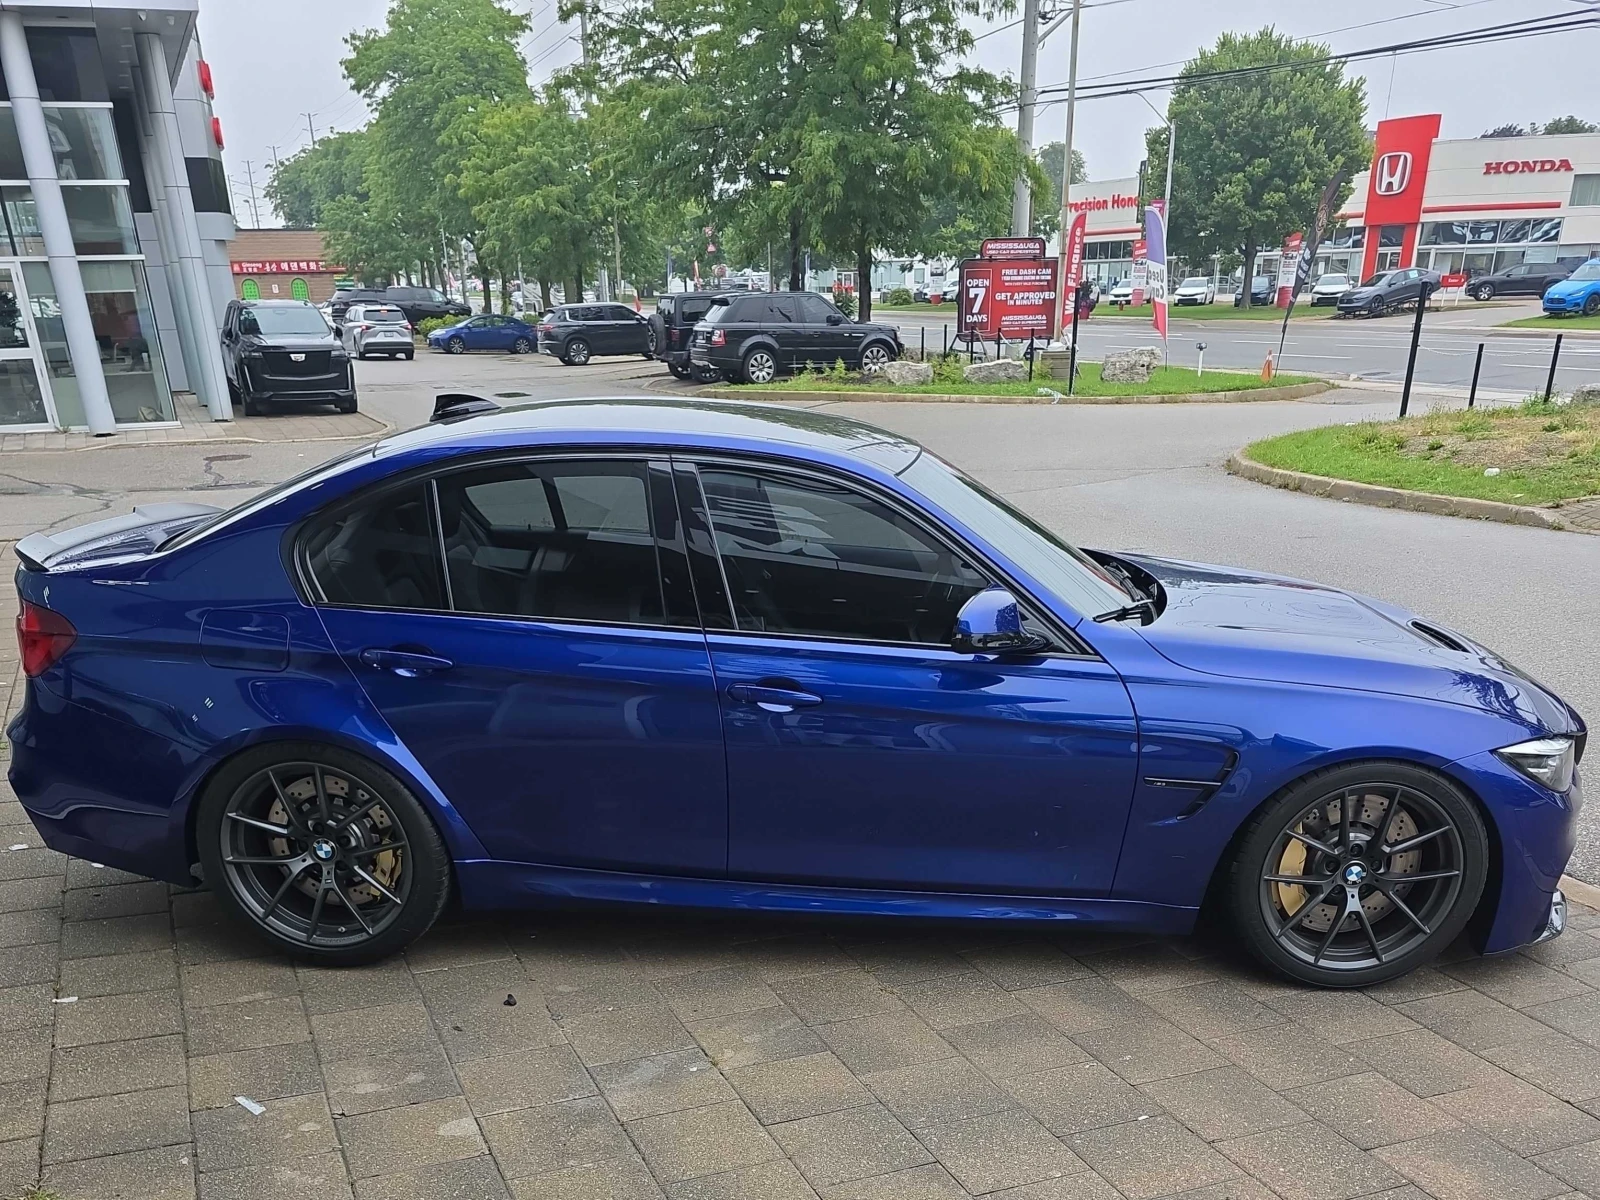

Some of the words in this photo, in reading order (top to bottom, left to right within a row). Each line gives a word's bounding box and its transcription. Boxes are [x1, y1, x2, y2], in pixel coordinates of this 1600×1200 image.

[1483, 159, 1574, 175] HONDA
[1066, 195, 1108, 213] recision
[1112, 193, 1140, 209] Hon
[986, 242, 1040, 250] MISSISSAUGA
[1067, 227, 1083, 287] Finance
[1001, 268, 1018, 276] FREE
[966, 278, 990, 287] OPEN
[969, 287, 986, 314] 7
[995, 292, 1012, 300] GET
[1013, 291, 1055, 300] APPROVED
[1065, 290, 1076, 315] We
[966, 314, 988, 323] DAYS
